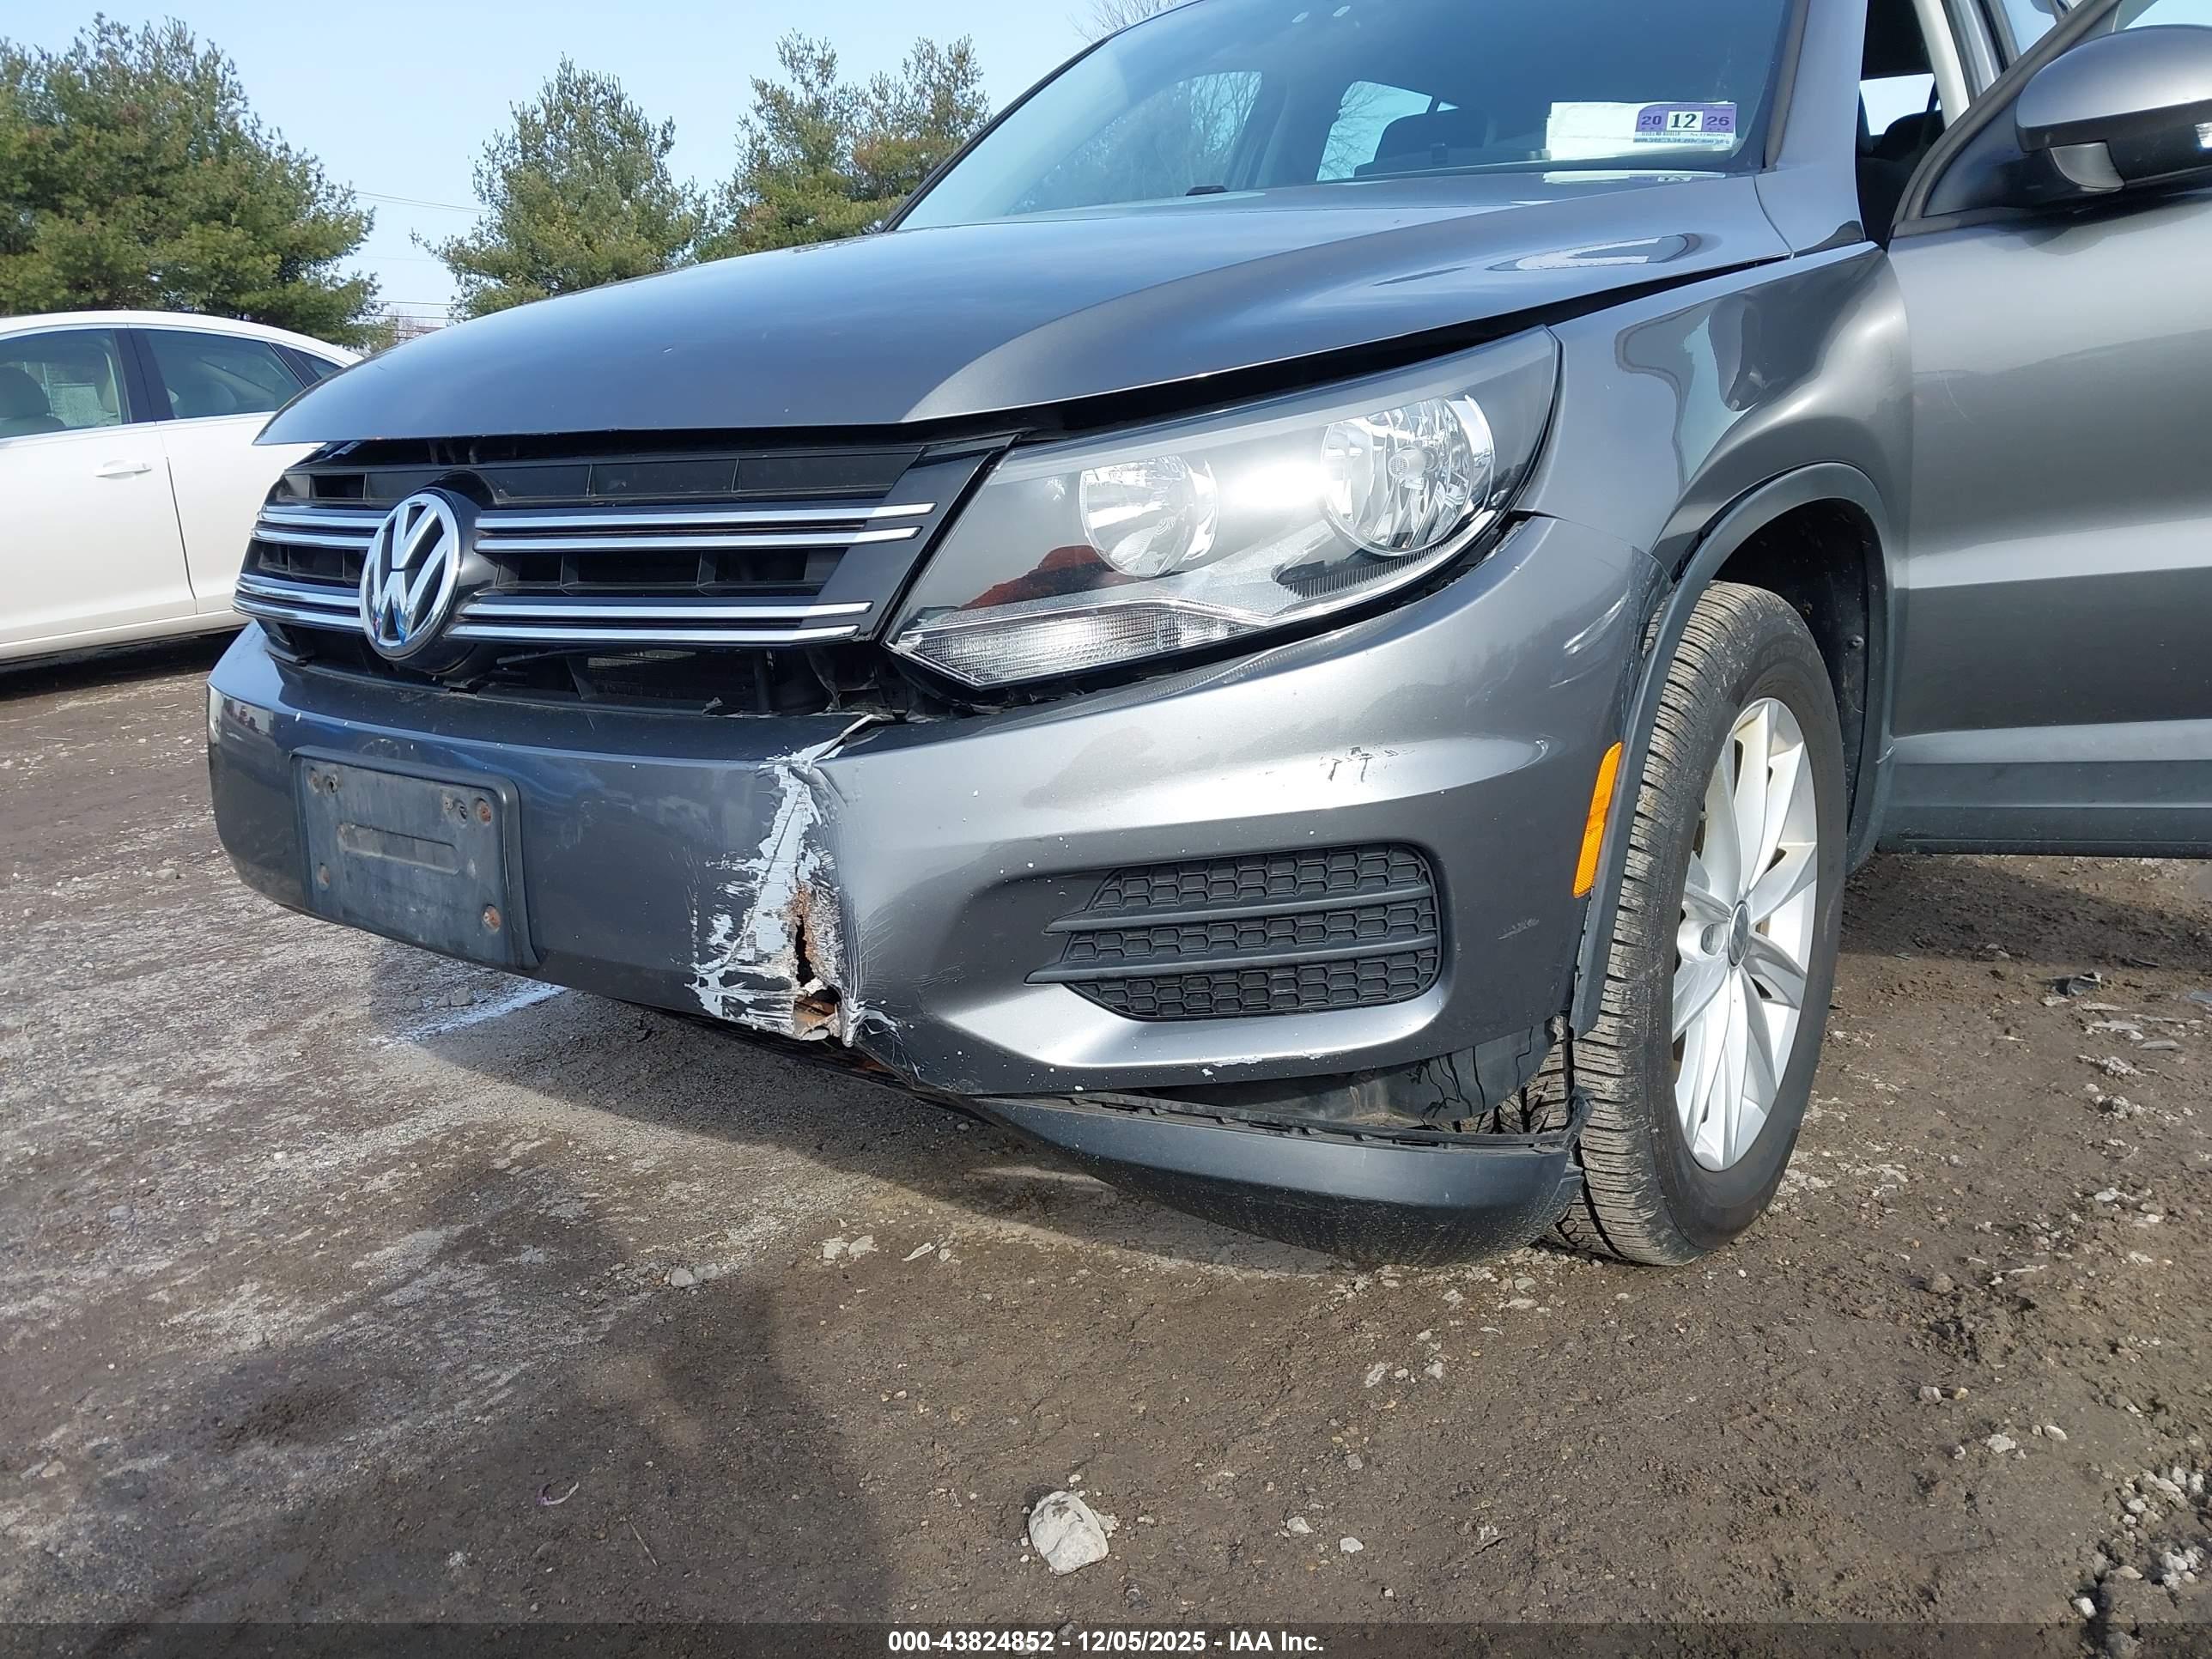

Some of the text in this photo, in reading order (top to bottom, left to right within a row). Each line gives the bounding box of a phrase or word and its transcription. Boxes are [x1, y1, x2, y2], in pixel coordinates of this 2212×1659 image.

[1641, 112, 1730, 129] 20 12 26
[362, 496, 459, 658] VW
